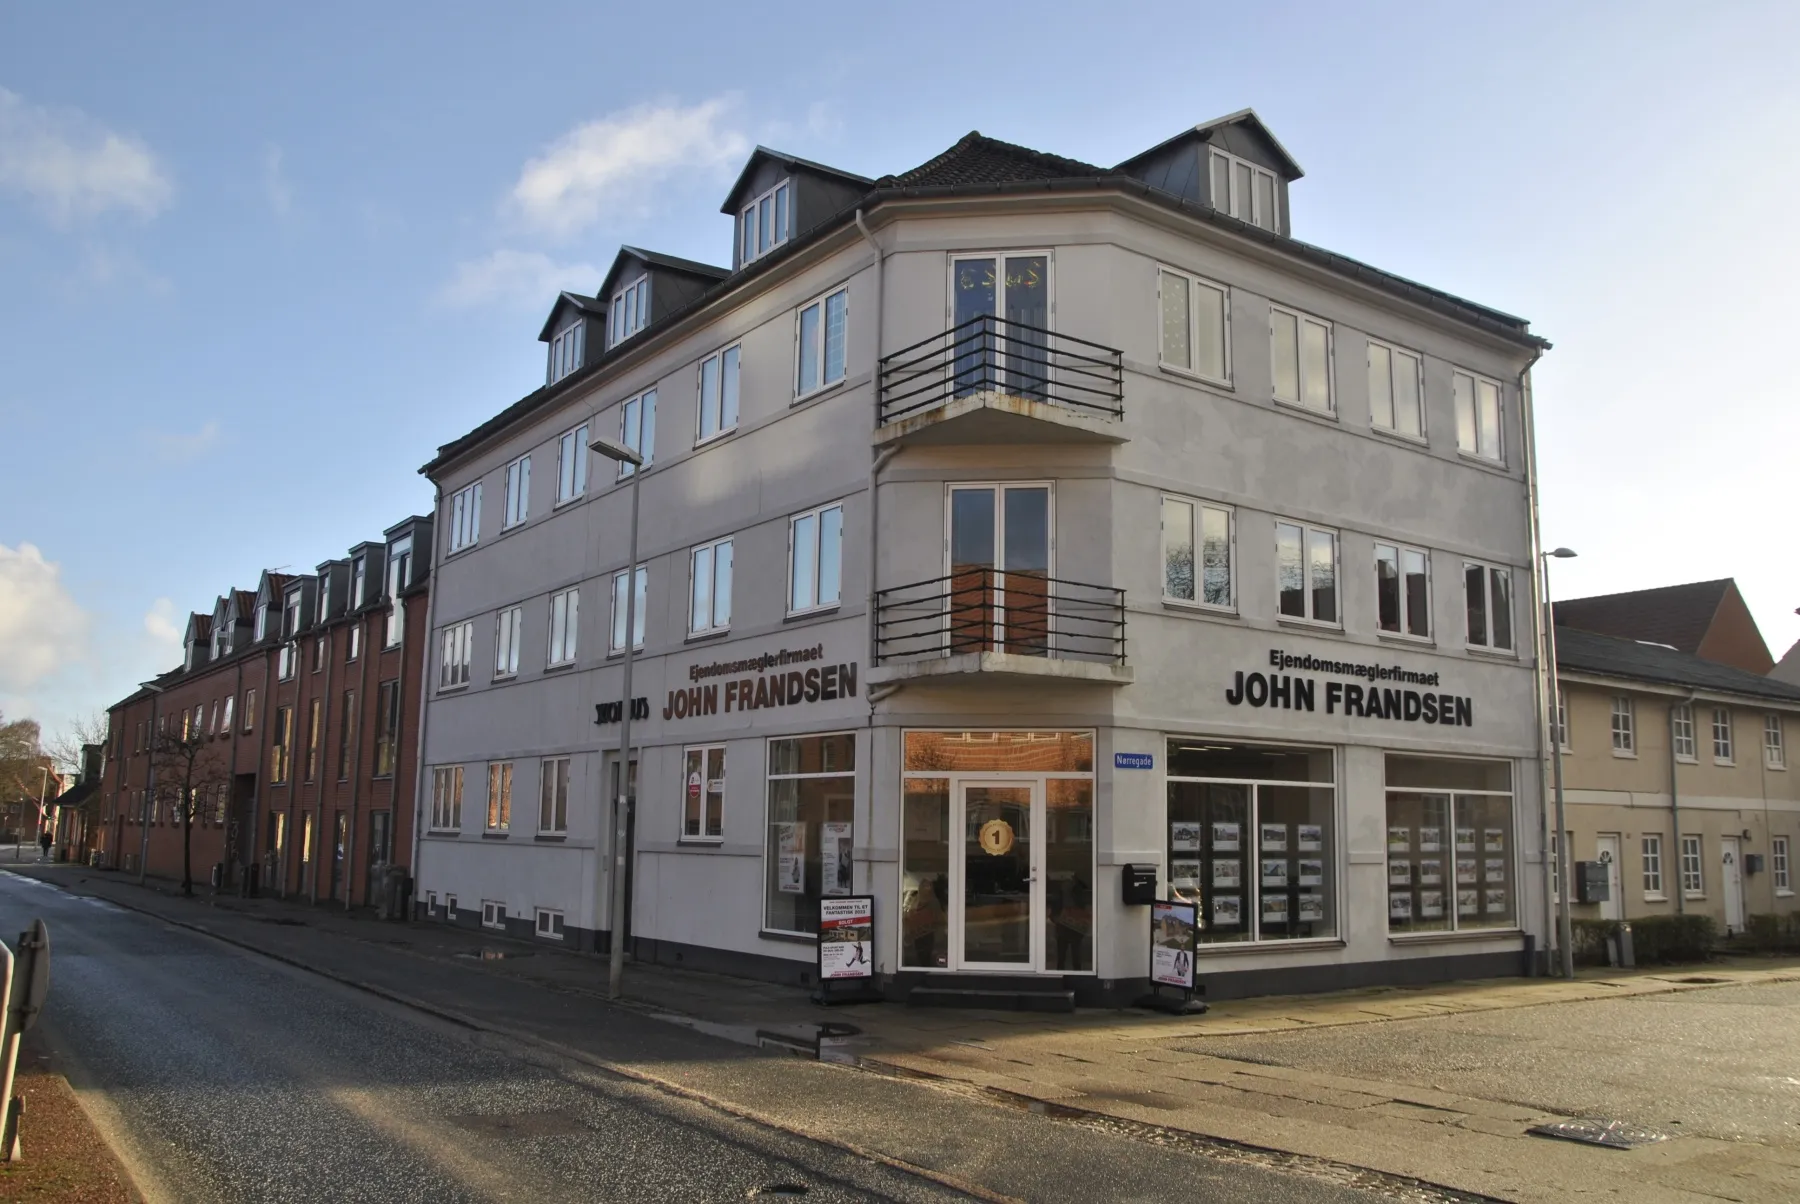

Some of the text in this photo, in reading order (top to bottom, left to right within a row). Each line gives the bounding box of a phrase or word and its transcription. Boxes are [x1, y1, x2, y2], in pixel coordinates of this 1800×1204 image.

[689, 642, 824, 683] Ejendomsmæglerfirmaet
[1269, 649, 1440, 686] Ejendomsmæglerfirmaet
[663, 683, 719, 721] JOHN
[724, 661, 857, 712] FRANDSEN
[1226, 670, 1473, 727] JOHN FRANDSEN
[1116, 754, 1152, 768] Nørregade
[991, 830, 1000, 845] 1
